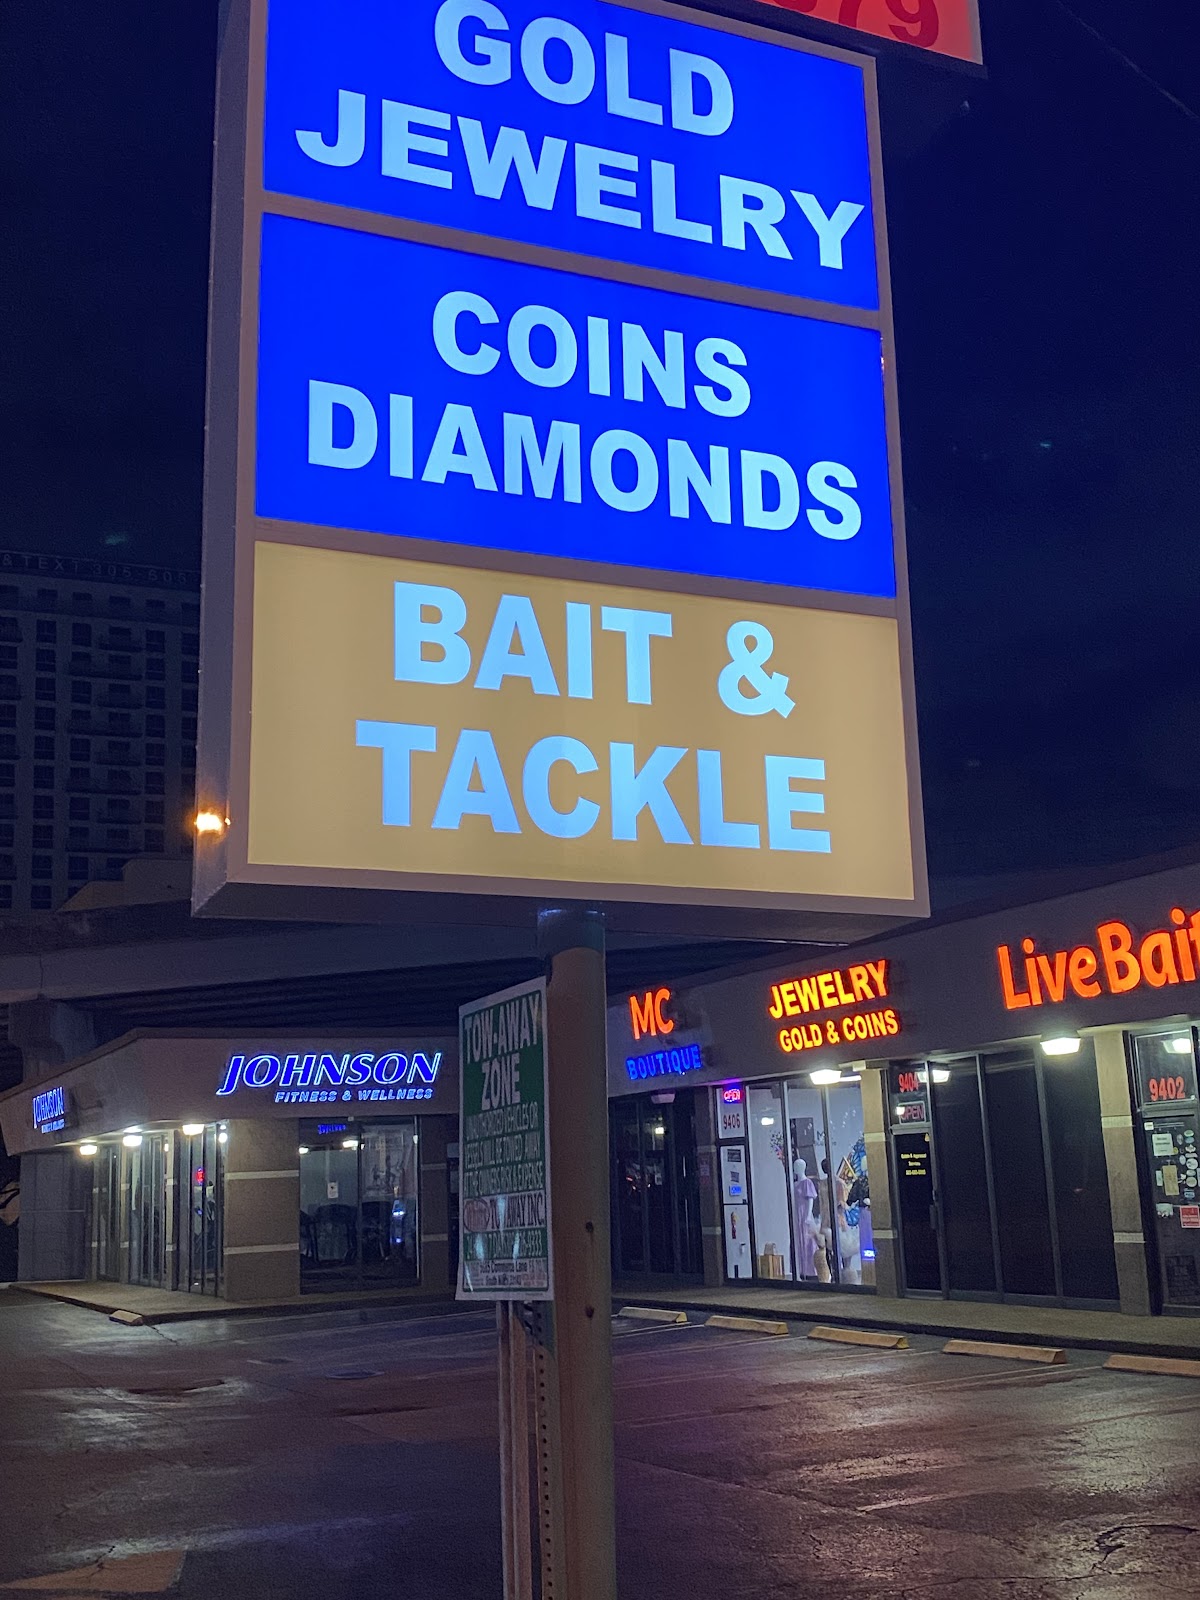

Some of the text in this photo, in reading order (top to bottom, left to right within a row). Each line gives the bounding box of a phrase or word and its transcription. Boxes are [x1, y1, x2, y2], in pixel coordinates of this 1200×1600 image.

[435, 0, 734, 136] GOLD
[296, 89, 865, 270] JEWELRY
[433, 291, 752, 419] COINS
[308, 380, 862, 541] DIAMONDS
[22, 555, 78, 574] TEXT
[394, 581, 795, 718] BAIT &
[355, 720, 833, 854] TACKLE
[629, 987, 675, 1040] MC
[769, 959, 887, 1019] JEWELRY
[464, 994, 541, 1065] TOW-AWAY
[779, 1009, 899, 1053] GOLD & COINS
[216, 1053, 441, 1096] JOHNSON
[481, 1053, 521, 1111] ZONE
[626, 1045, 702, 1081] BOUTIQUE
[1149, 1076, 1185, 1102] 9402
[274, 1088, 433, 1103] FITNESS & WELLNESS
[723, 1113, 741, 1130] 9406
